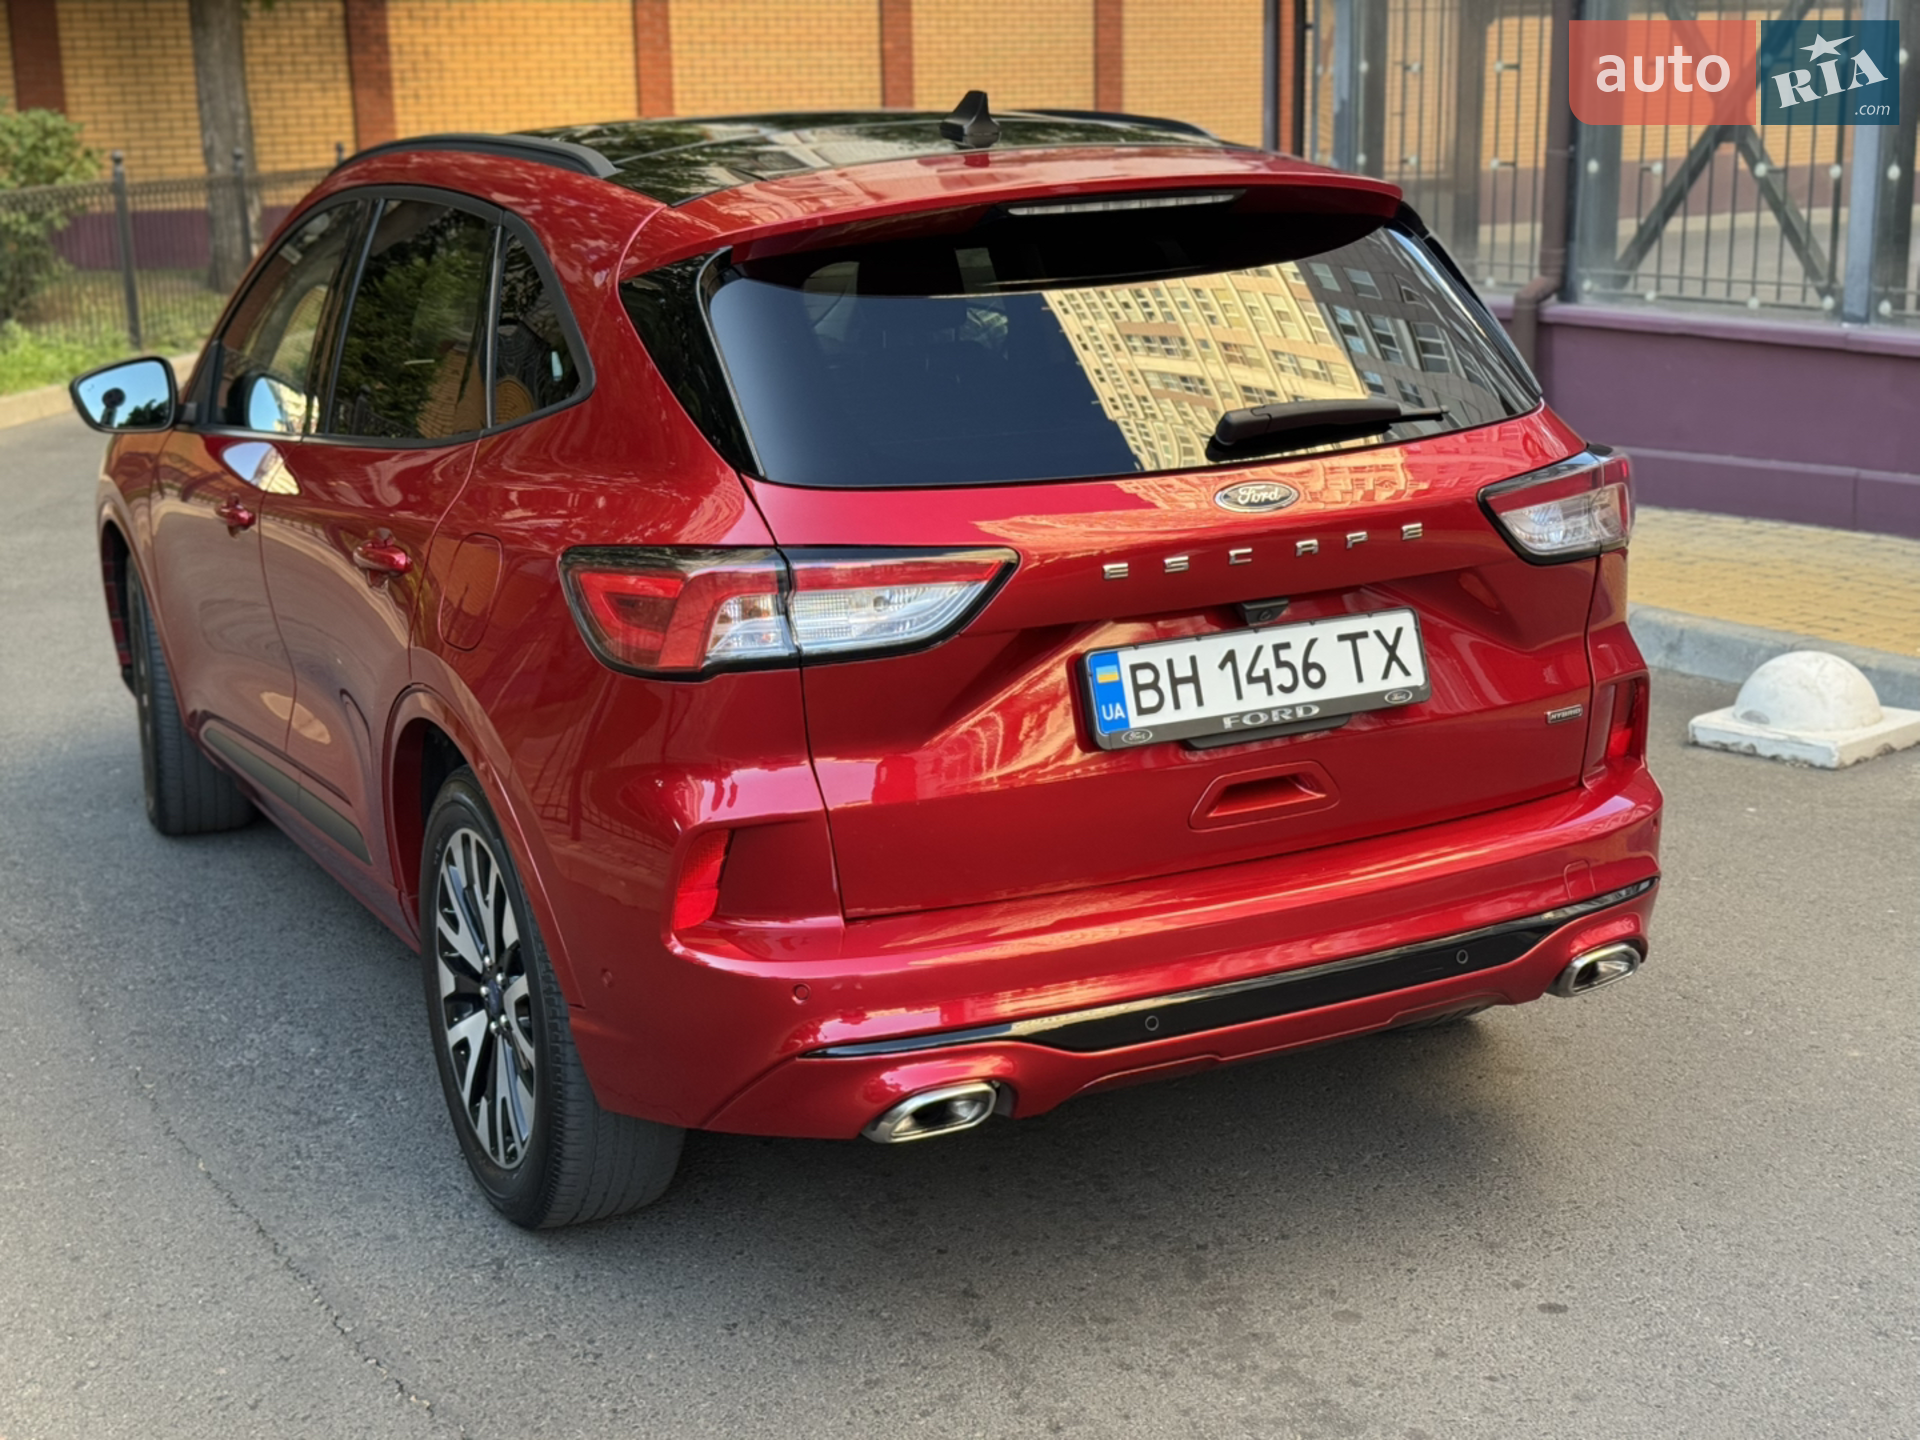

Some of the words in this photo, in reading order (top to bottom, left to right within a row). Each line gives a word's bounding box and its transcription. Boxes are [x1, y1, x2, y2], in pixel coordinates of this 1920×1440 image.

[1238, 485, 1280, 505] Ford
[1103, 522, 1423, 580] ESCAPE
[1129, 655, 1204, 717] BH
[1217, 637, 1327, 701] 1456
[1337, 626, 1412, 684] TX
[1101, 702, 1126, 721] UA
[1223, 703, 1320, 730] FORD
